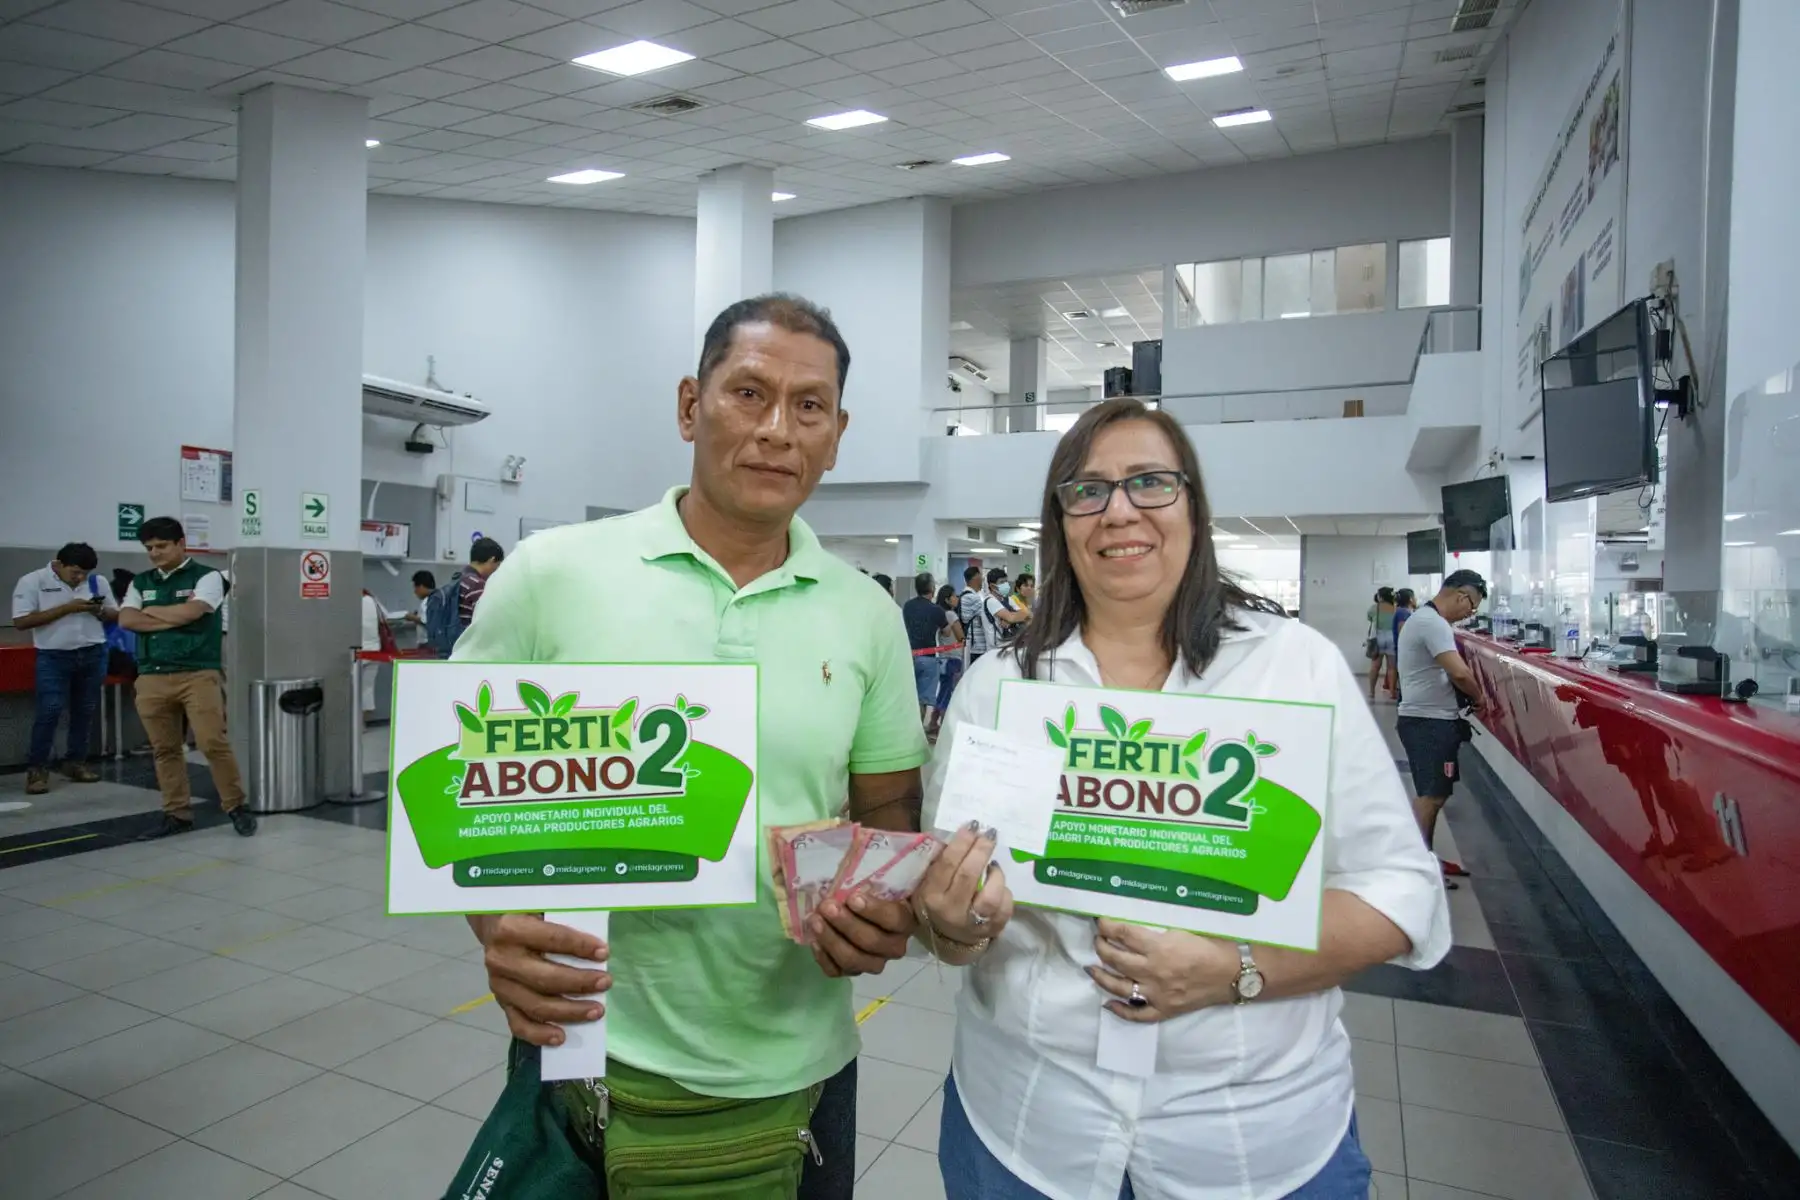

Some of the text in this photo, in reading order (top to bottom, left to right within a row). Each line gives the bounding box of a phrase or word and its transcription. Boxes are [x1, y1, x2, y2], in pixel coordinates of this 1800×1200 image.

[1026, 393, 1034, 402] S
[246, 492, 256, 516] S
[304, 525, 326, 533] SALIDA
[918, 555, 926, 565] S
[1024, 564, 1031, 572] S
[485, 715, 610, 753] FERTI
[459, 708, 688, 799] ABONO 2
[1068, 737, 1181, 775] FERTI
[1203, 742, 1256, 822] 2
[473, 803, 671, 825] APOYO MONETARIO INDIVIDUAL DEL
[459, 815, 684, 838] MIDAGRI PARA PRODUCTORES AGRARIOS
[1053, 820, 1232, 845] APOYO MONETARIO INDIVIDUAL DEL
[1048, 831, 1247, 859] IDAGRI PARA PRODUCTORES AGRARIOS
[482, 865, 534, 877] midagriperu
[555, 864, 607, 876] midagriperu
[1058, 869, 1103, 882] midagriperu
[1120, 879, 1168, 892] midagriperu
